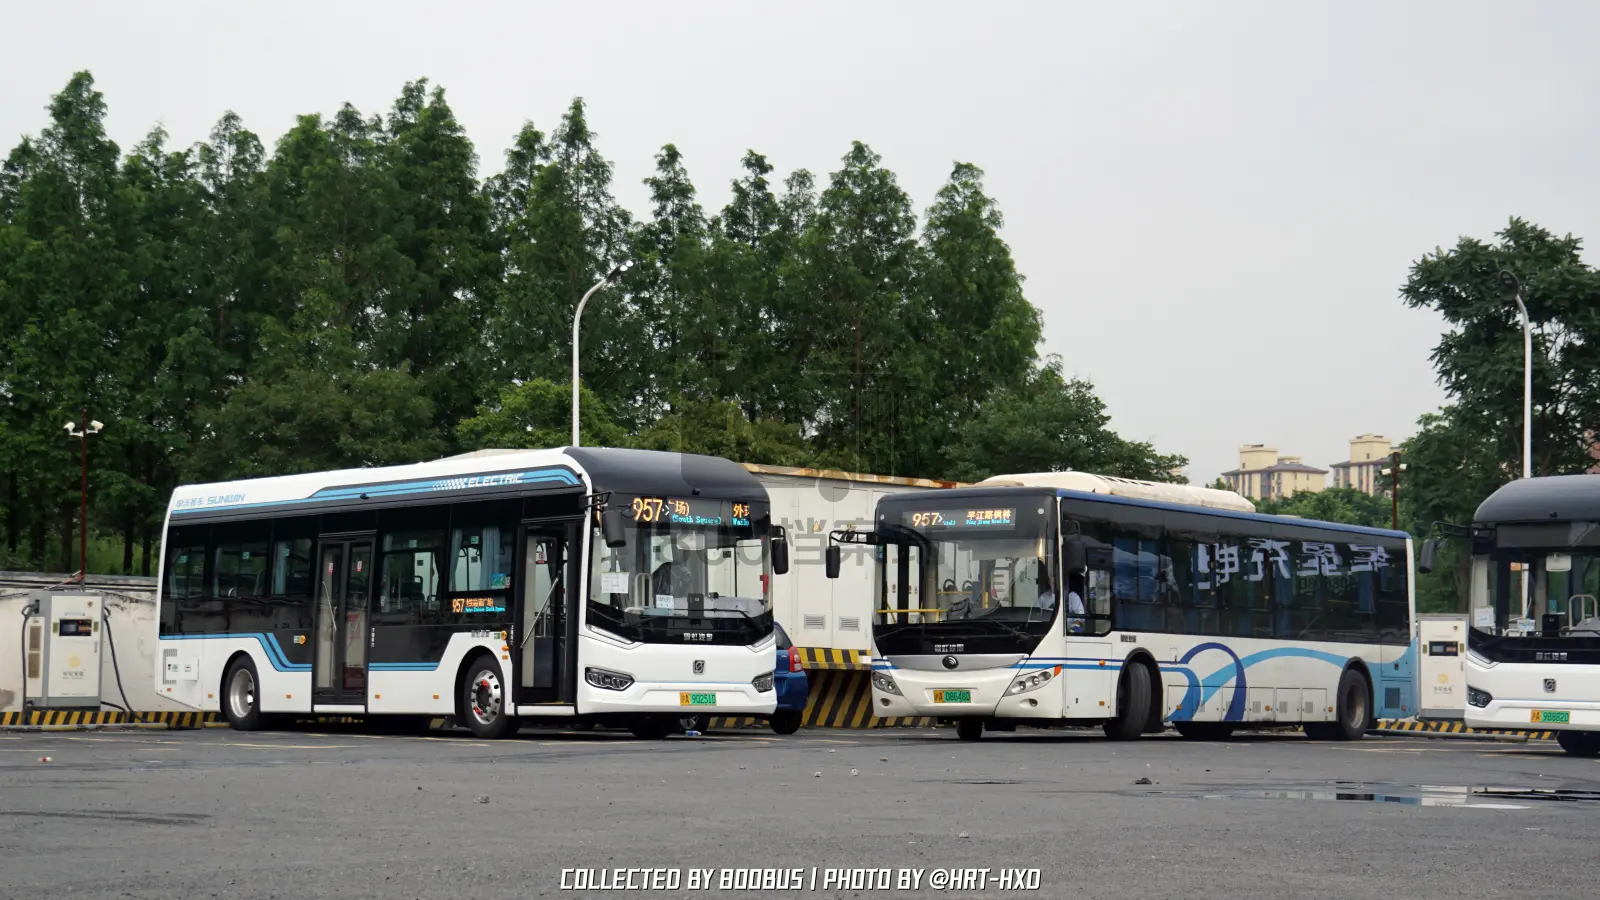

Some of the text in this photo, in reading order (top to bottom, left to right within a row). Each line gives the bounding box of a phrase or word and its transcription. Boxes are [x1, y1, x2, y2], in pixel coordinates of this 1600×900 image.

[468, 473, 524, 488] ELECTRIC
[207, 494, 245, 505] SUNWIN
[633, 498, 663, 522] 957
[912, 512, 940, 527] 957
[452, 598, 465, 613] 957
